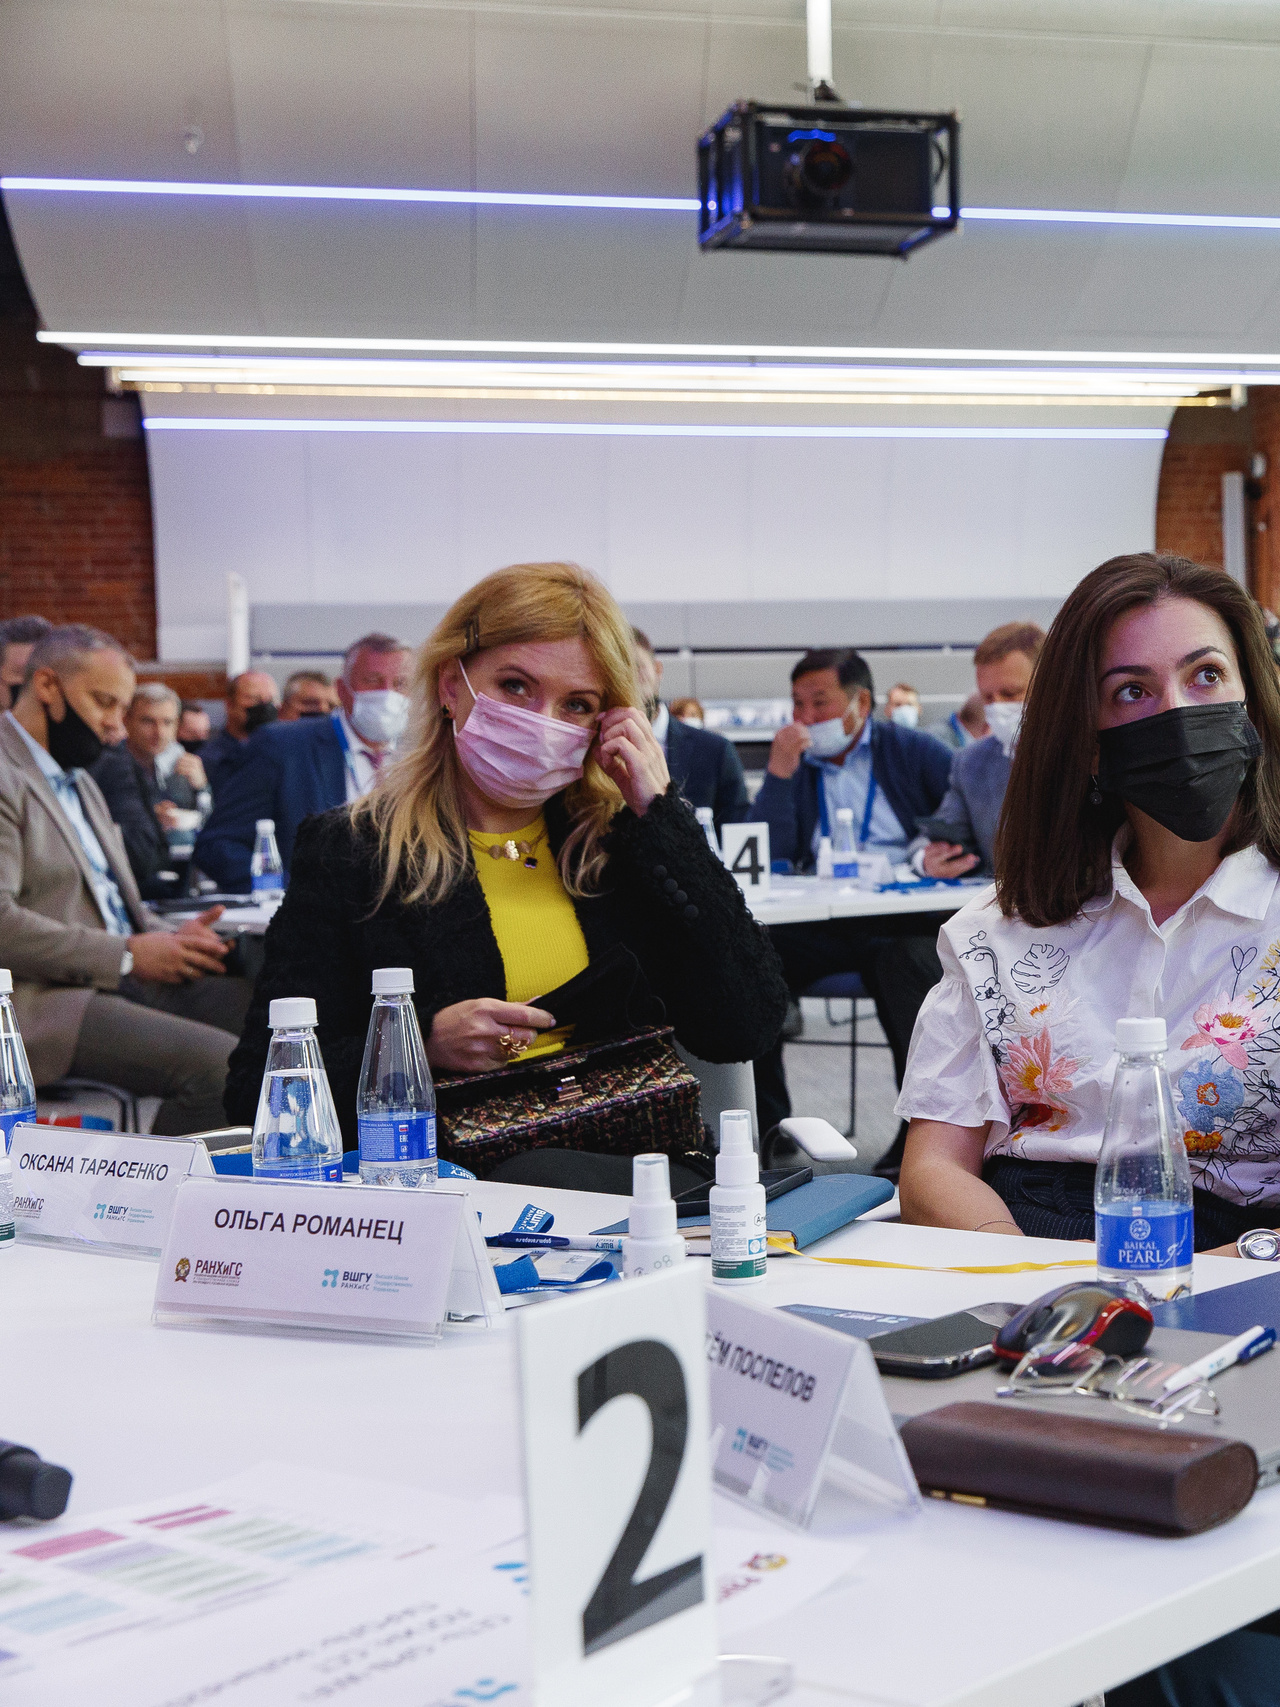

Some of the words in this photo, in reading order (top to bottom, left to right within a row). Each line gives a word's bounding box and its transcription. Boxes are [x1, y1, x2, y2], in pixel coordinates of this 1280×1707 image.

[732, 836, 764, 885] 4
[19, 1153, 74, 1173] ОКСАНА
[79, 1158, 168, 1182] ТАРАСЕНКО
[14, 1196, 44, 1210] РАНХиГС
[108, 1205, 129, 1216] ВШГУ
[214, 1208, 285, 1232] ОЛЬГА
[292, 1214, 404, 1244] РОМАНЕЦ
[526, 1209, 546, 1231] ВШГУ
[1124, 1241, 1158, 1250] BAIKAL
[1118, 1250, 1164, 1263] PEARL
[194, 1260, 243, 1276] РАНХиГС
[342, 1271, 372, 1283] ВШГУ
[341, 1282, 370, 1290] РАНХиГС
[729, 1346, 817, 1402] ПОСПЕЛОВ
[575, 1337, 706, 1661] 2
